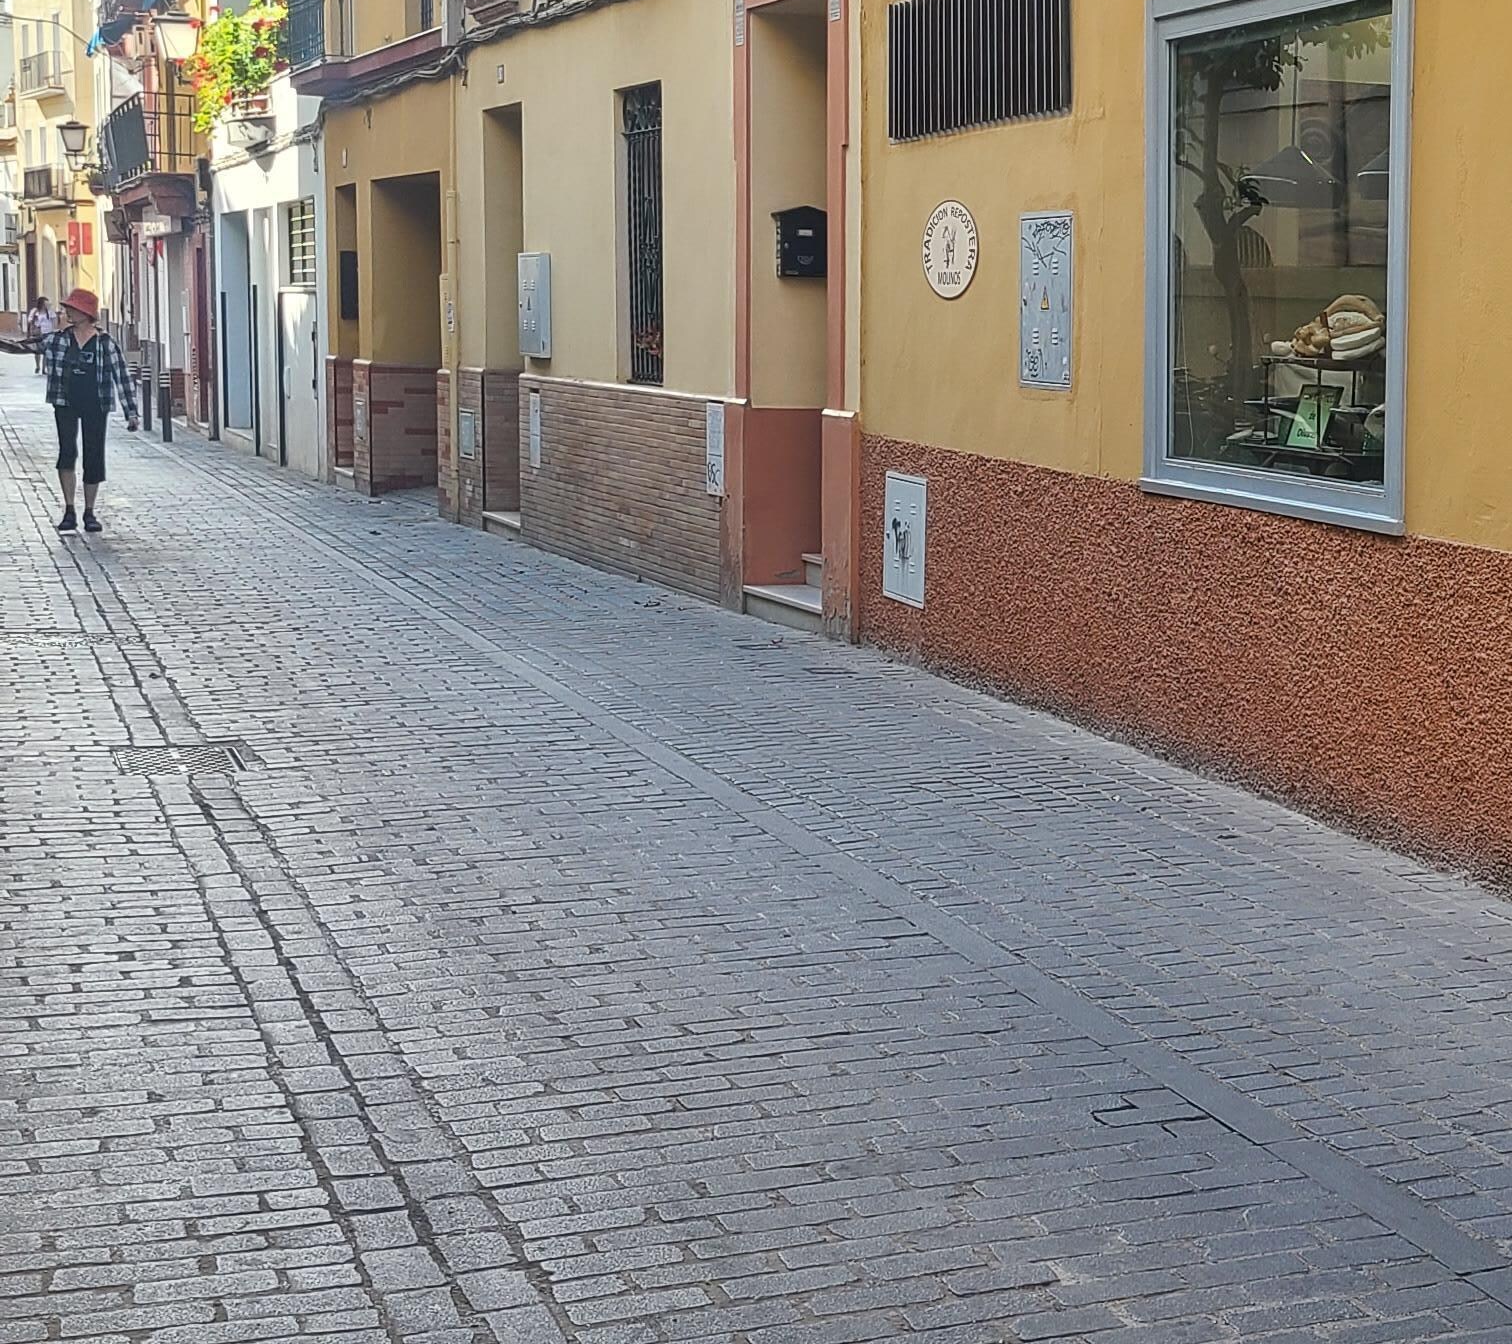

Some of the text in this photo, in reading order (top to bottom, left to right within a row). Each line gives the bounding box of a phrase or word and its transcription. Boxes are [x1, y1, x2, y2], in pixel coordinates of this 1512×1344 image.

[923, 206, 976, 274] TRADICION REPOSTERA
[937, 271, 961, 286] MOLINOS
